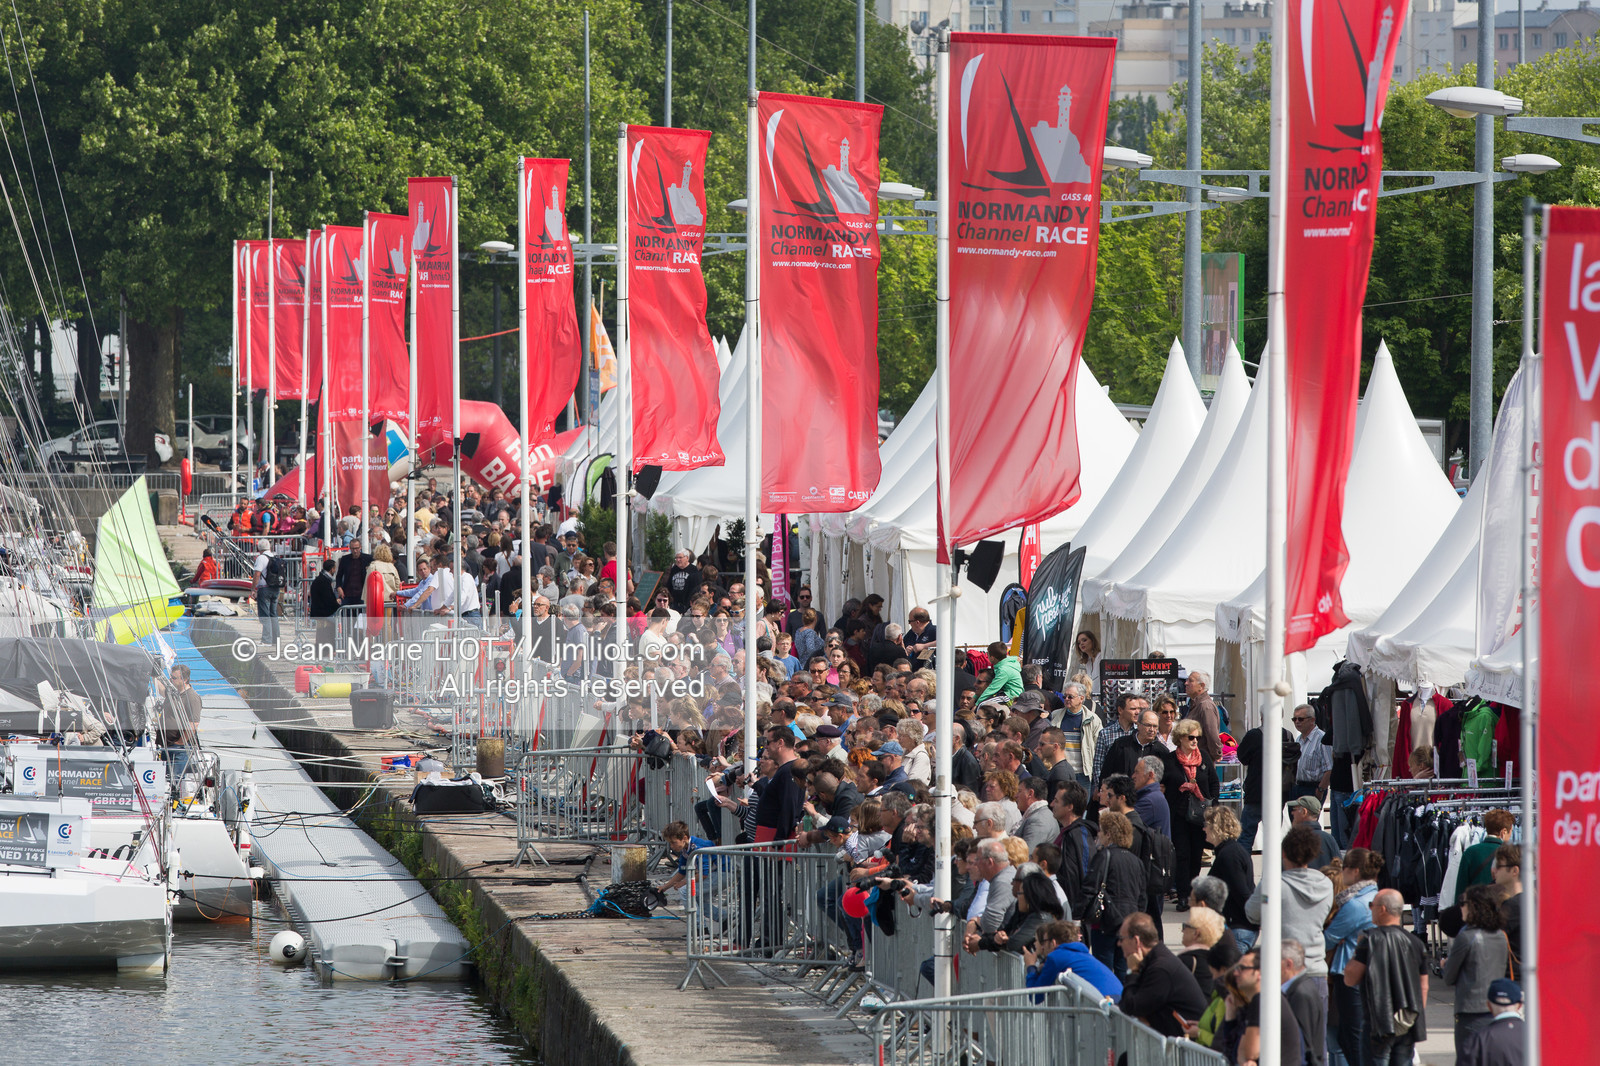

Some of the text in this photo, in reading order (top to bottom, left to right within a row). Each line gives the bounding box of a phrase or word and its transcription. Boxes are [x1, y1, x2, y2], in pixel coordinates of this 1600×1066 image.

[958, 201, 1090, 224] NORMANDY
[771, 224, 871, 246] NORMANDY
[957, 222, 1089, 245] Channel RACE
[771, 241, 873, 259] Channel RACE
[957, 246, 1057, 258] www.normandy-race.com
[772, 260, 852, 269] www.normandy-race.com
[848, 490, 869, 500] CAEN
[1141, 660, 1172, 670] isotoner
[47, 769, 103, 779] NORMANDY
[47, 777, 102, 786] Chnnel RACE
[93, 796, 132, 806] GBR 82
[1553, 812, 1583, 846] de
[25, 852, 45, 862] 141
